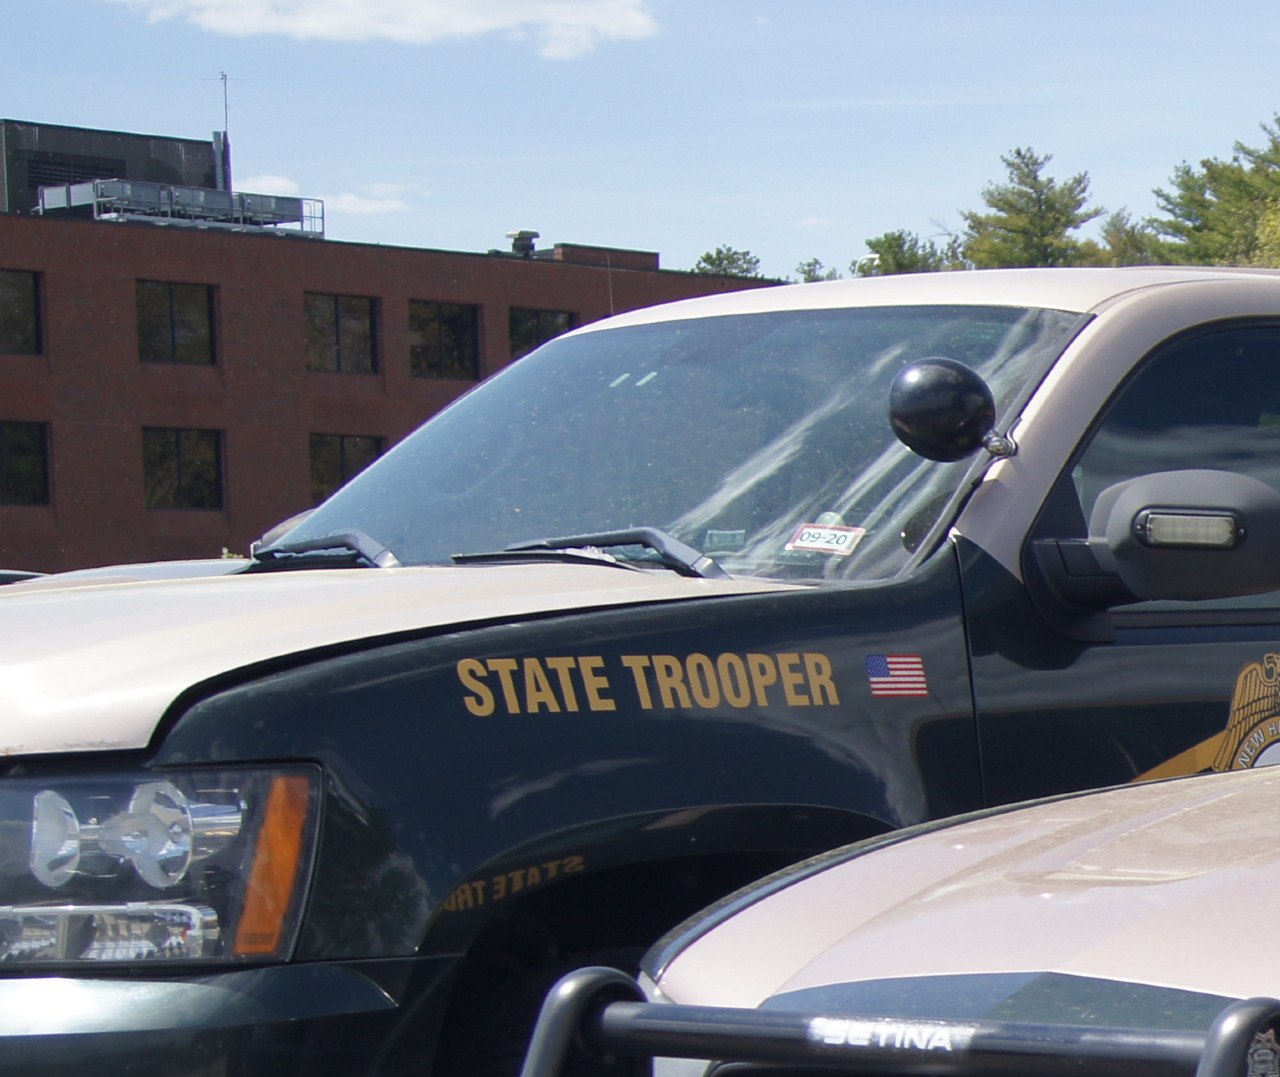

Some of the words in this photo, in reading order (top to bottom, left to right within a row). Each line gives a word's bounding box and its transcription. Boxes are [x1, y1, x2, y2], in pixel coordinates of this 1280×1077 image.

[799, 531, 848, 546] 09-20
[457, 656, 617, 717] STATE
[621, 652, 841, 710] TROOPER
[1238, 728, 1265, 768] NEW
[823, 1020, 953, 1051] SETINA
